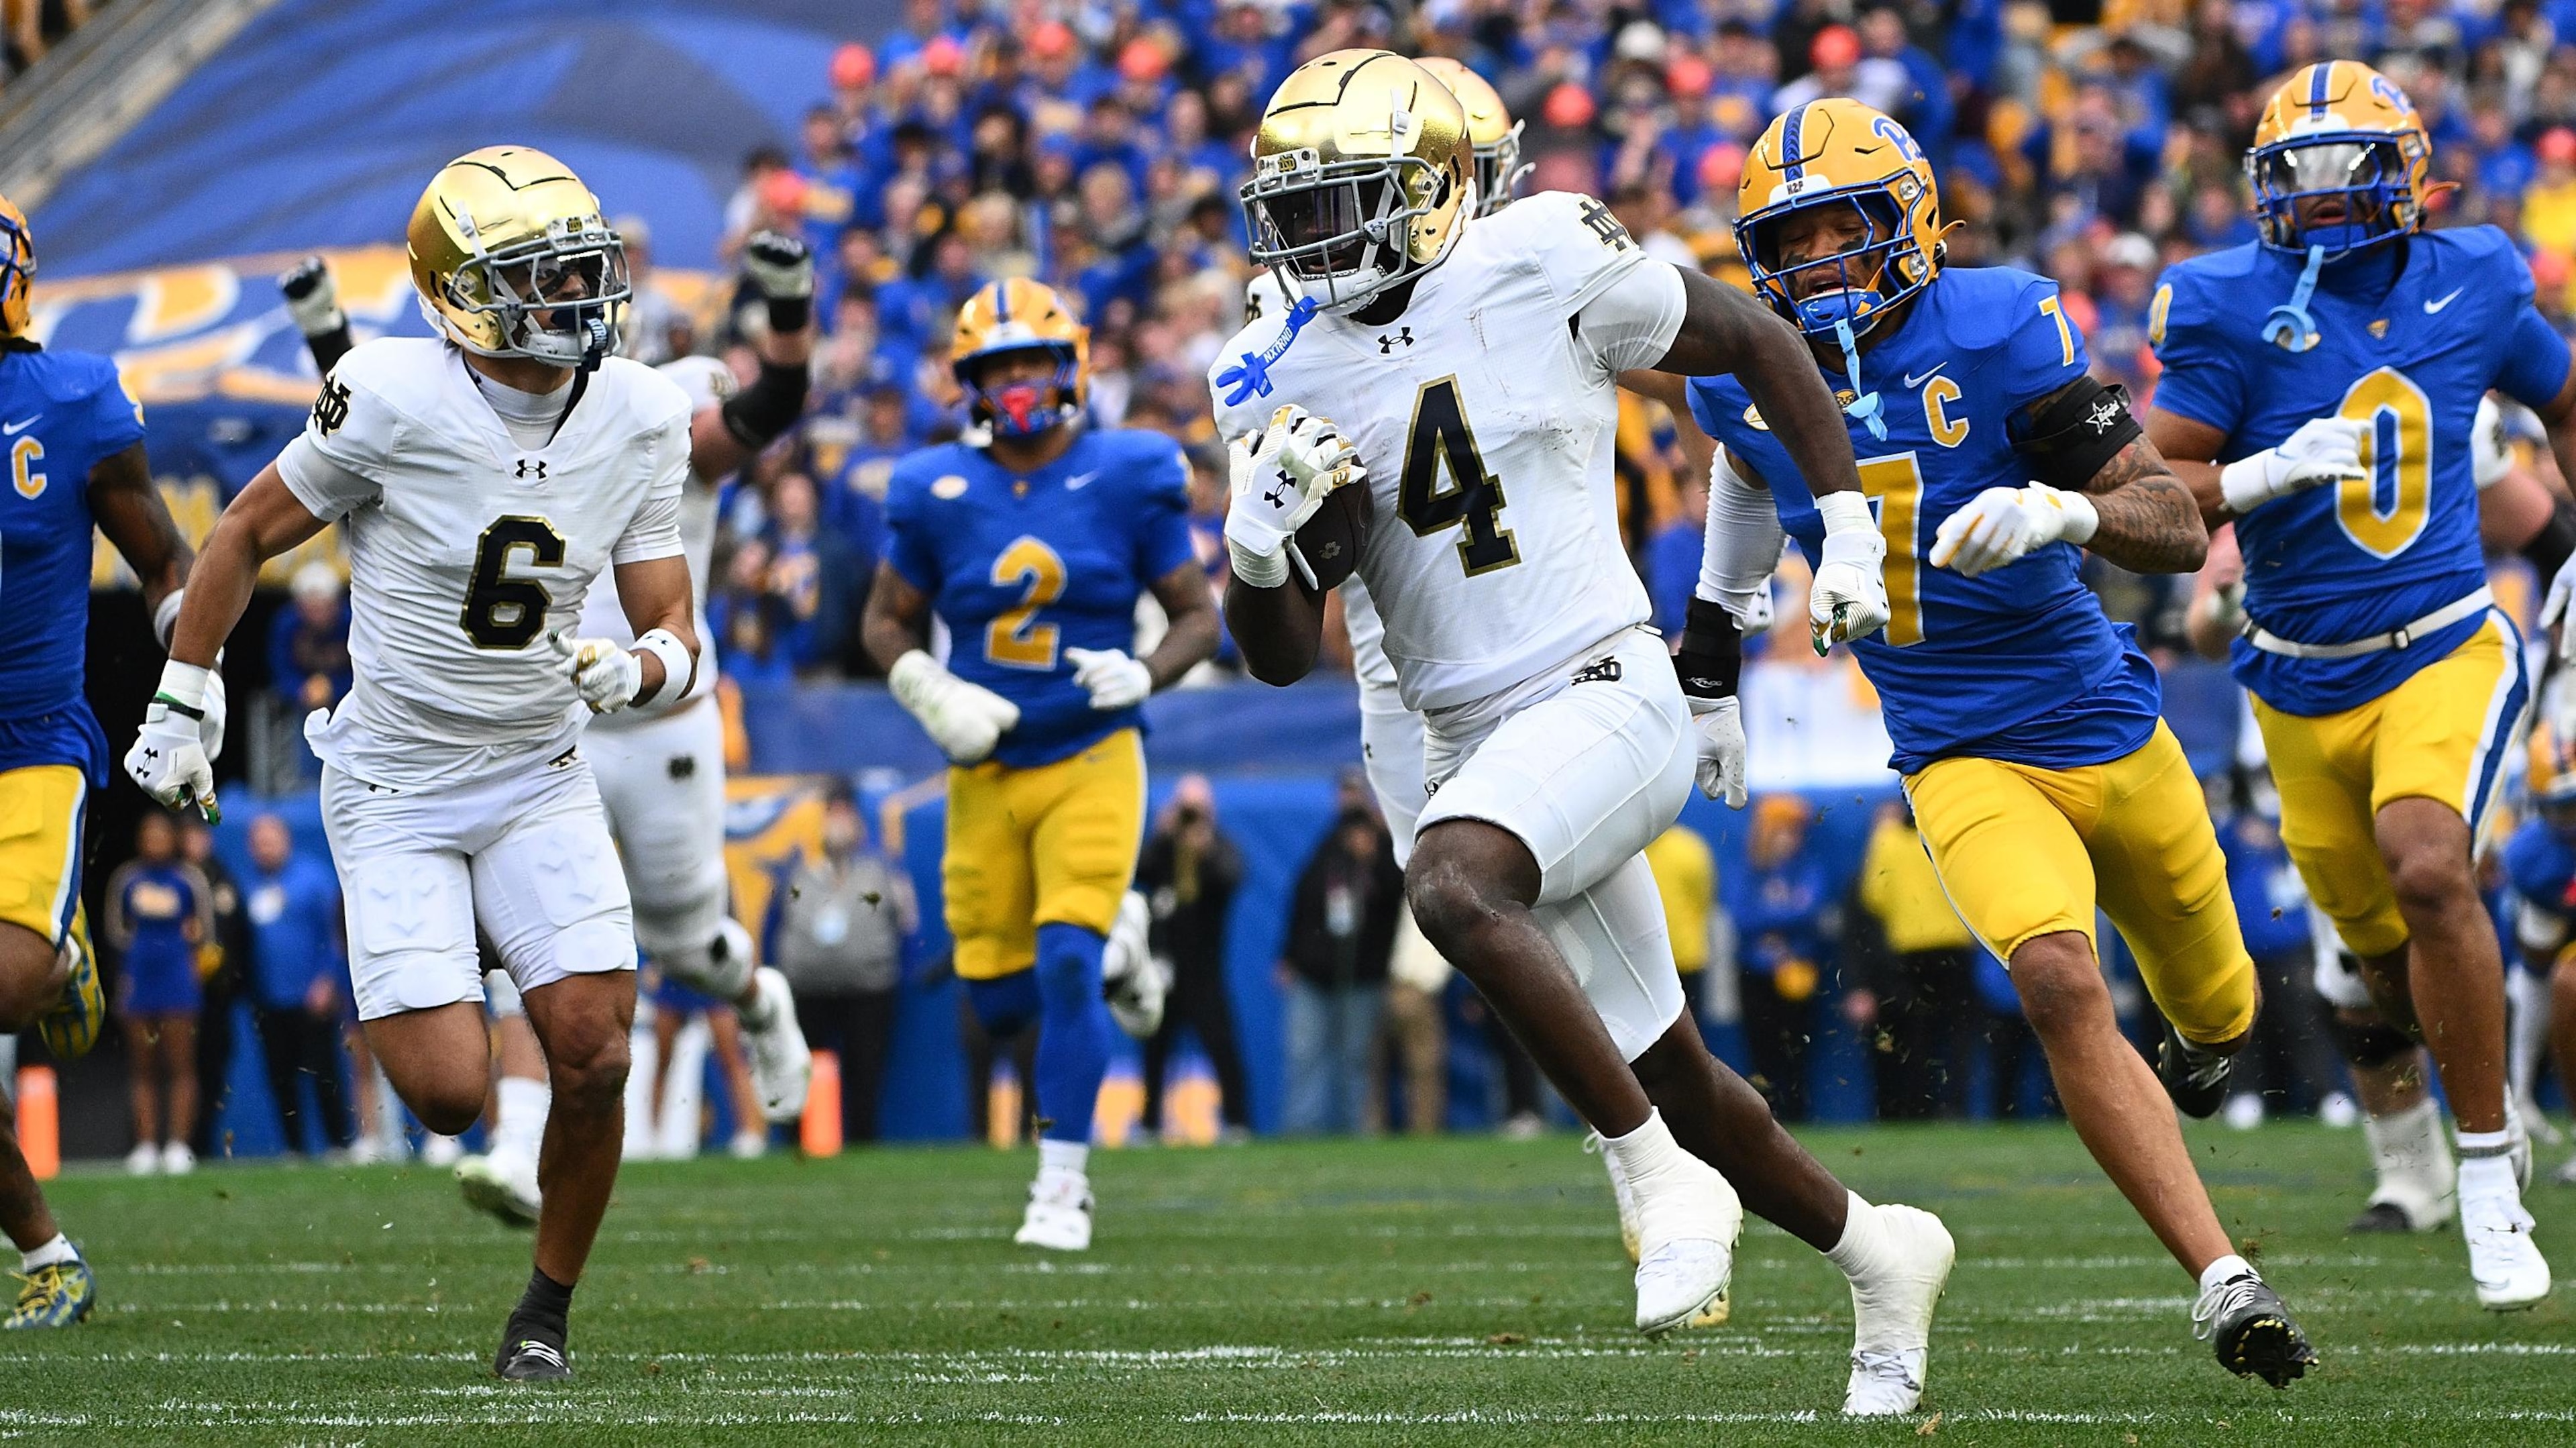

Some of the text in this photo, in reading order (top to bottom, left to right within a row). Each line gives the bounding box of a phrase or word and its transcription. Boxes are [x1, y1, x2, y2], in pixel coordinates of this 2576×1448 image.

[1786, 180, 1803, 195] H2P
[1263, 327, 1294, 364] NXTRND
[2038, 295, 2074, 367] 7
[2148, 282, 2173, 345] 0
[1922, 374, 1970, 448] C
[11, 434, 48, 501] C
[1397, 374, 1521, 578] 4
[2334, 365, 2434, 561] 0
[459, 514, 566, 651] 6
[1856, 450, 1927, 649] 7
[984, 535, 1068, 671] 2
